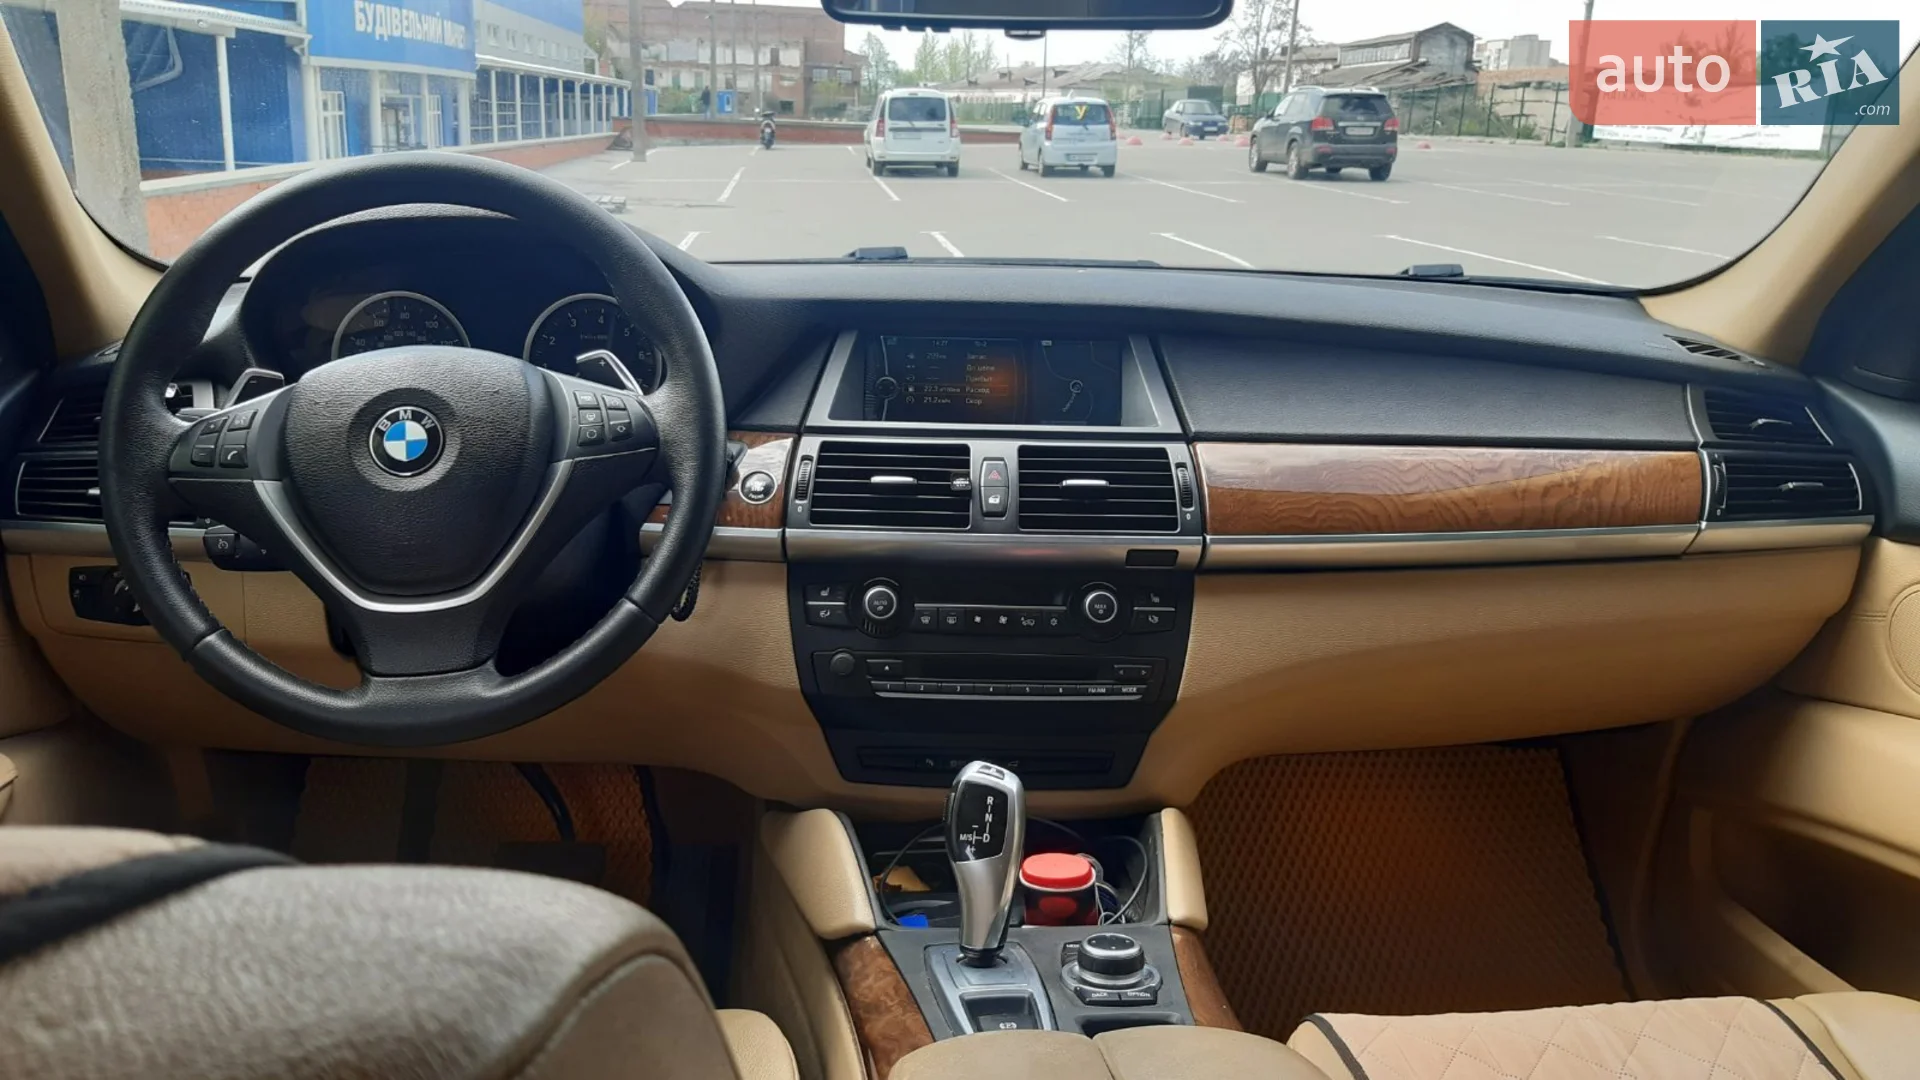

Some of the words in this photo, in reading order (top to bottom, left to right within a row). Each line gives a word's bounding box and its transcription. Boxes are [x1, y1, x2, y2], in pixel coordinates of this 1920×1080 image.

[354, 0, 444, 44] БУДІВЕЛЬНИЙ
[425, 320, 439, 329] 100
[570, 318, 577, 328] 3
[598, 315, 604, 324] 4
[623, 327, 630, 337] 5
[549, 336, 556, 345] 2
[638, 351, 645, 360] 6
[377, 409, 436, 432] BMW
[986, 796, 994, 805] R
[984, 813, 993, 823] N
[982, 833, 991, 843] D
